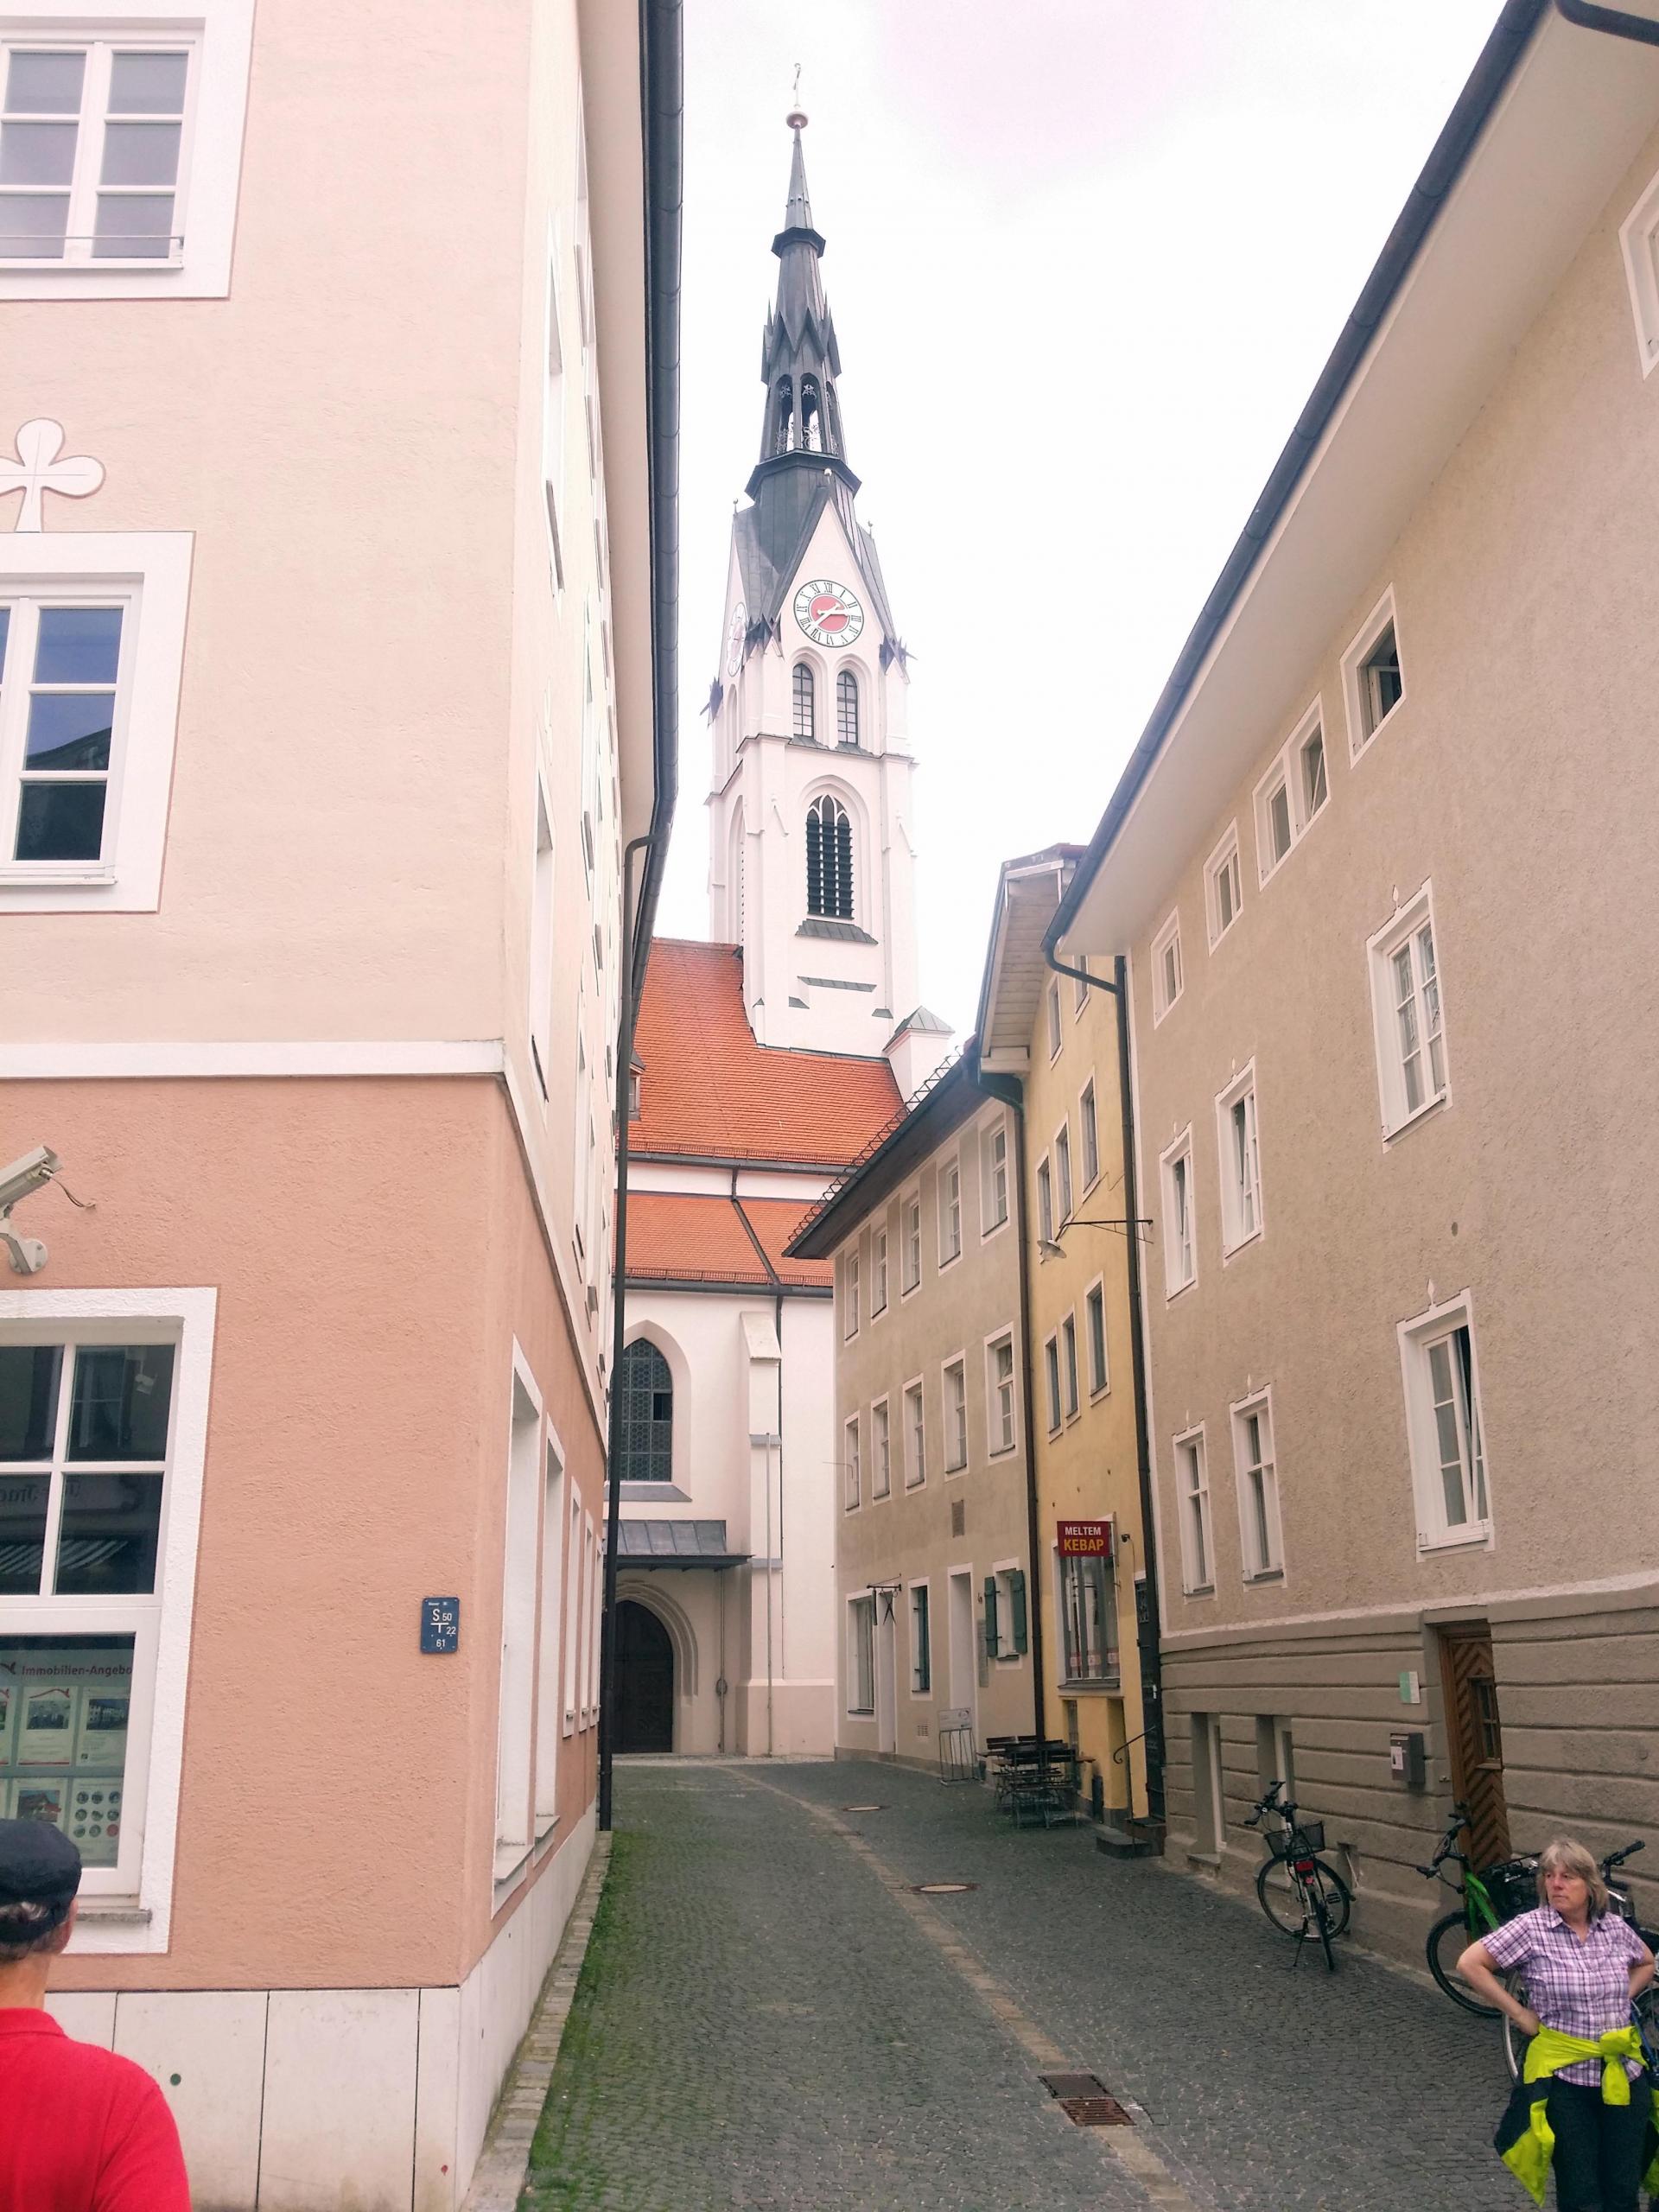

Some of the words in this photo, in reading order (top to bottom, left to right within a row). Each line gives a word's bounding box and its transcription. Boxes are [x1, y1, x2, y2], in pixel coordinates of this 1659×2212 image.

[1065, 1526, 1102, 1535] MELTEM
[1064, 1539, 1104, 1551] KEBAP
[432, 1608, 441, 1622] S
[442, 1612, 453, 1622] 50
